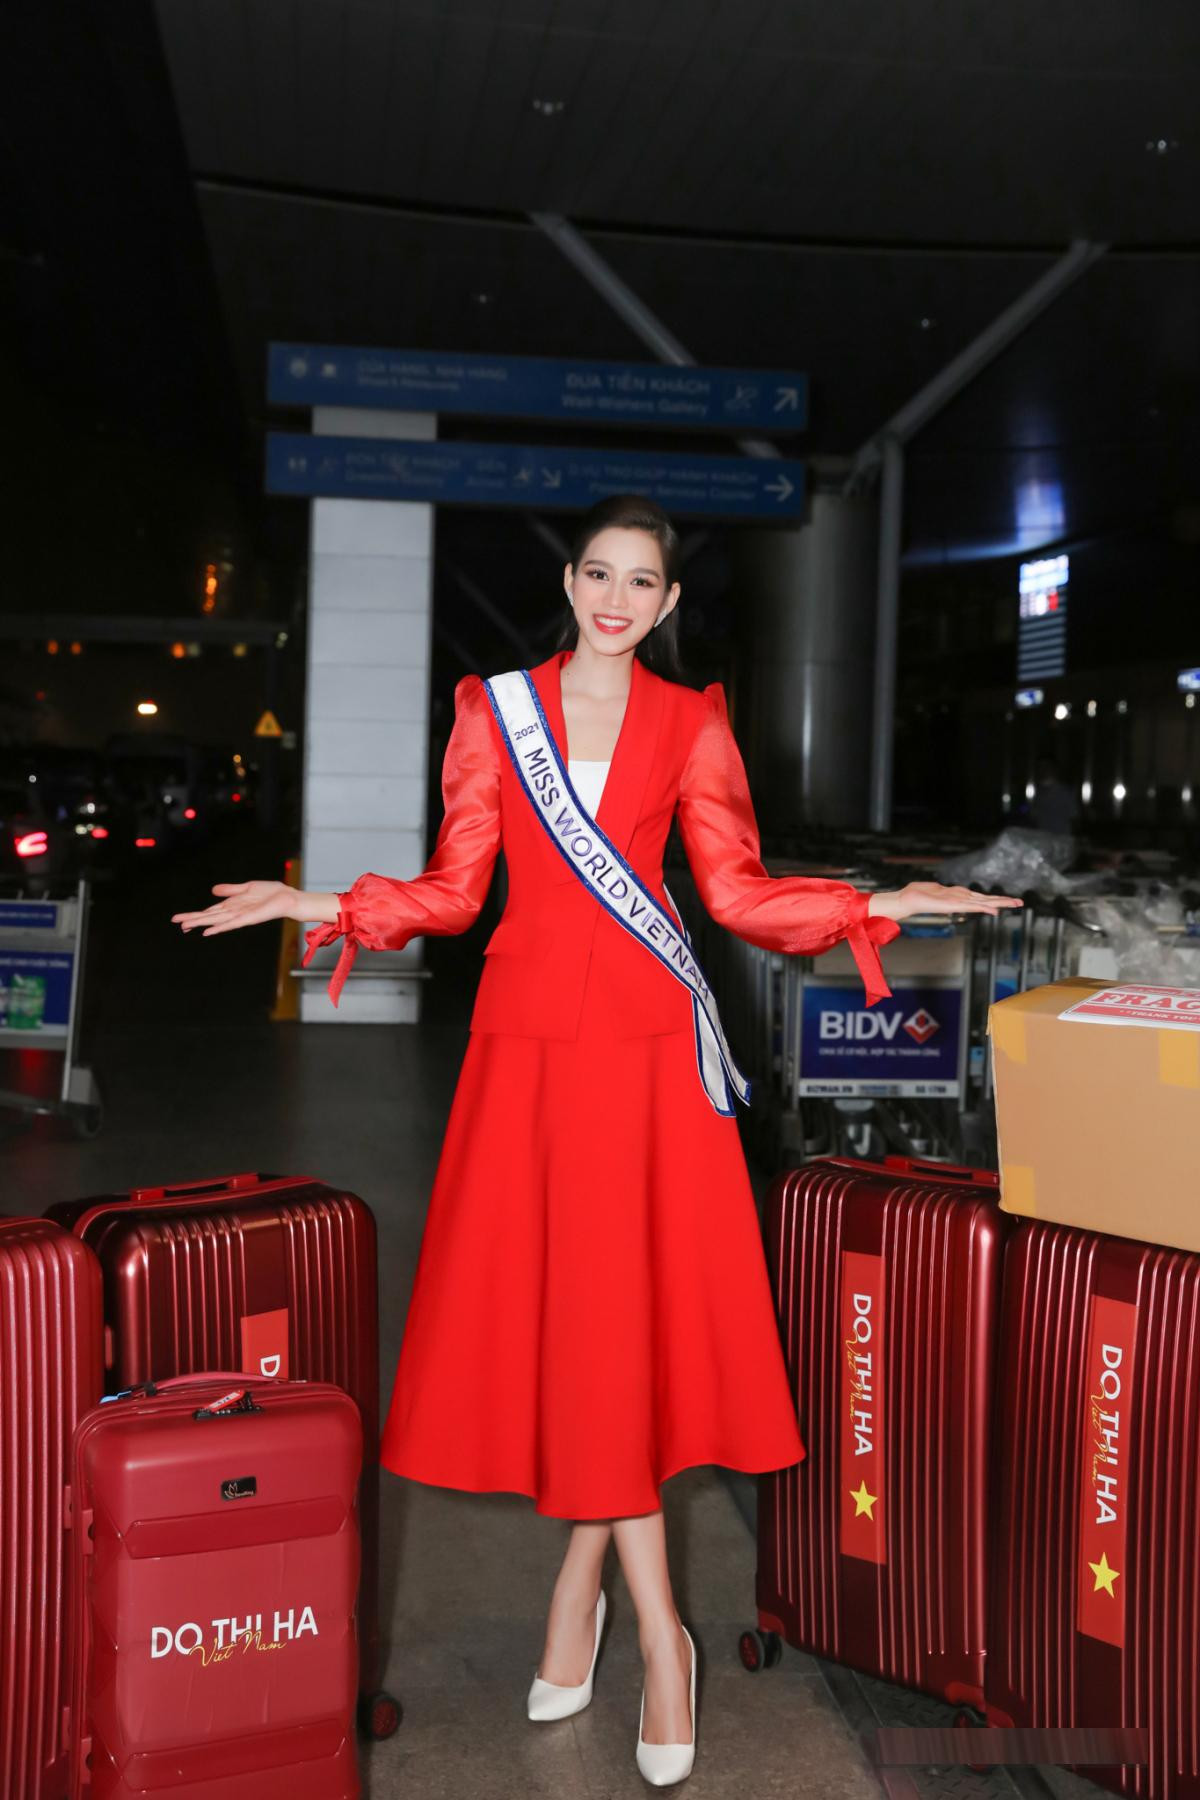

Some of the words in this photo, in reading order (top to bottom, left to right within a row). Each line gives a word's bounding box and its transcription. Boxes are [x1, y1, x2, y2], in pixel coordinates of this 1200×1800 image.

[514, 722, 540, 741] 2021
[524, 747, 560, 808] MISS
[554, 807, 629, 900] WORLD
[819, 1010, 903, 1041] BIDV
[853, 1293, 873, 1344] DO
[854, 1352, 873, 1402] THI
[1100, 1343, 1123, 1400] DO
[854, 1410, 874, 1457] HA
[1099, 1411, 1120, 1466] THI
[1095, 1473, 1118, 1525] HA
[151, 1622, 204, 1659] DO
[211, 1614, 262, 1650] THI
[273, 1606, 319, 1642] HA
